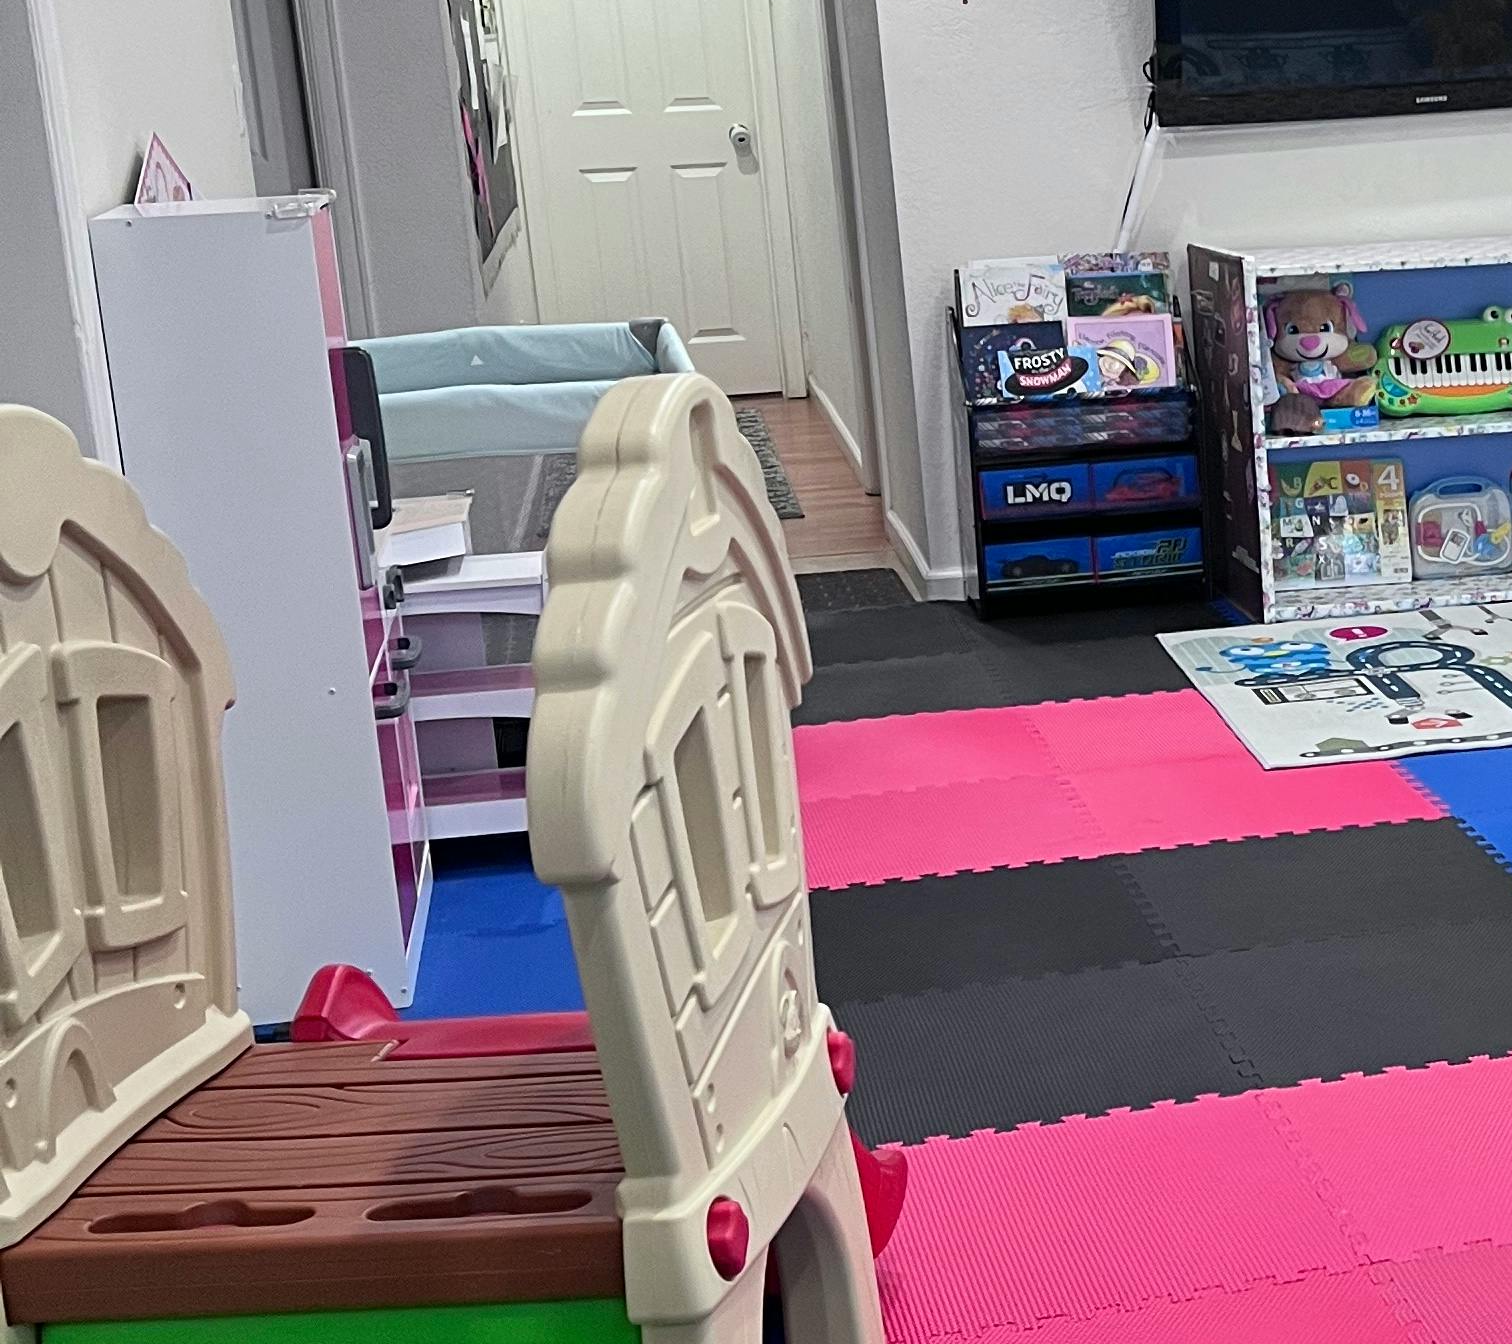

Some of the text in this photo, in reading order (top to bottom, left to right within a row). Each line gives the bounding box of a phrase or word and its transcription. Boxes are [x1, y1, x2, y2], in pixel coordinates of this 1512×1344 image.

[966, 278, 1013, 317] Alice
[1011, 273, 1064, 315] Fairy
[1014, 348, 1065, 370] FROSTY
[1020, 364, 1072, 387] SNOWMAN
[1377, 464, 1400, 490] 4
[1006, 481, 1072, 505] LMQ
